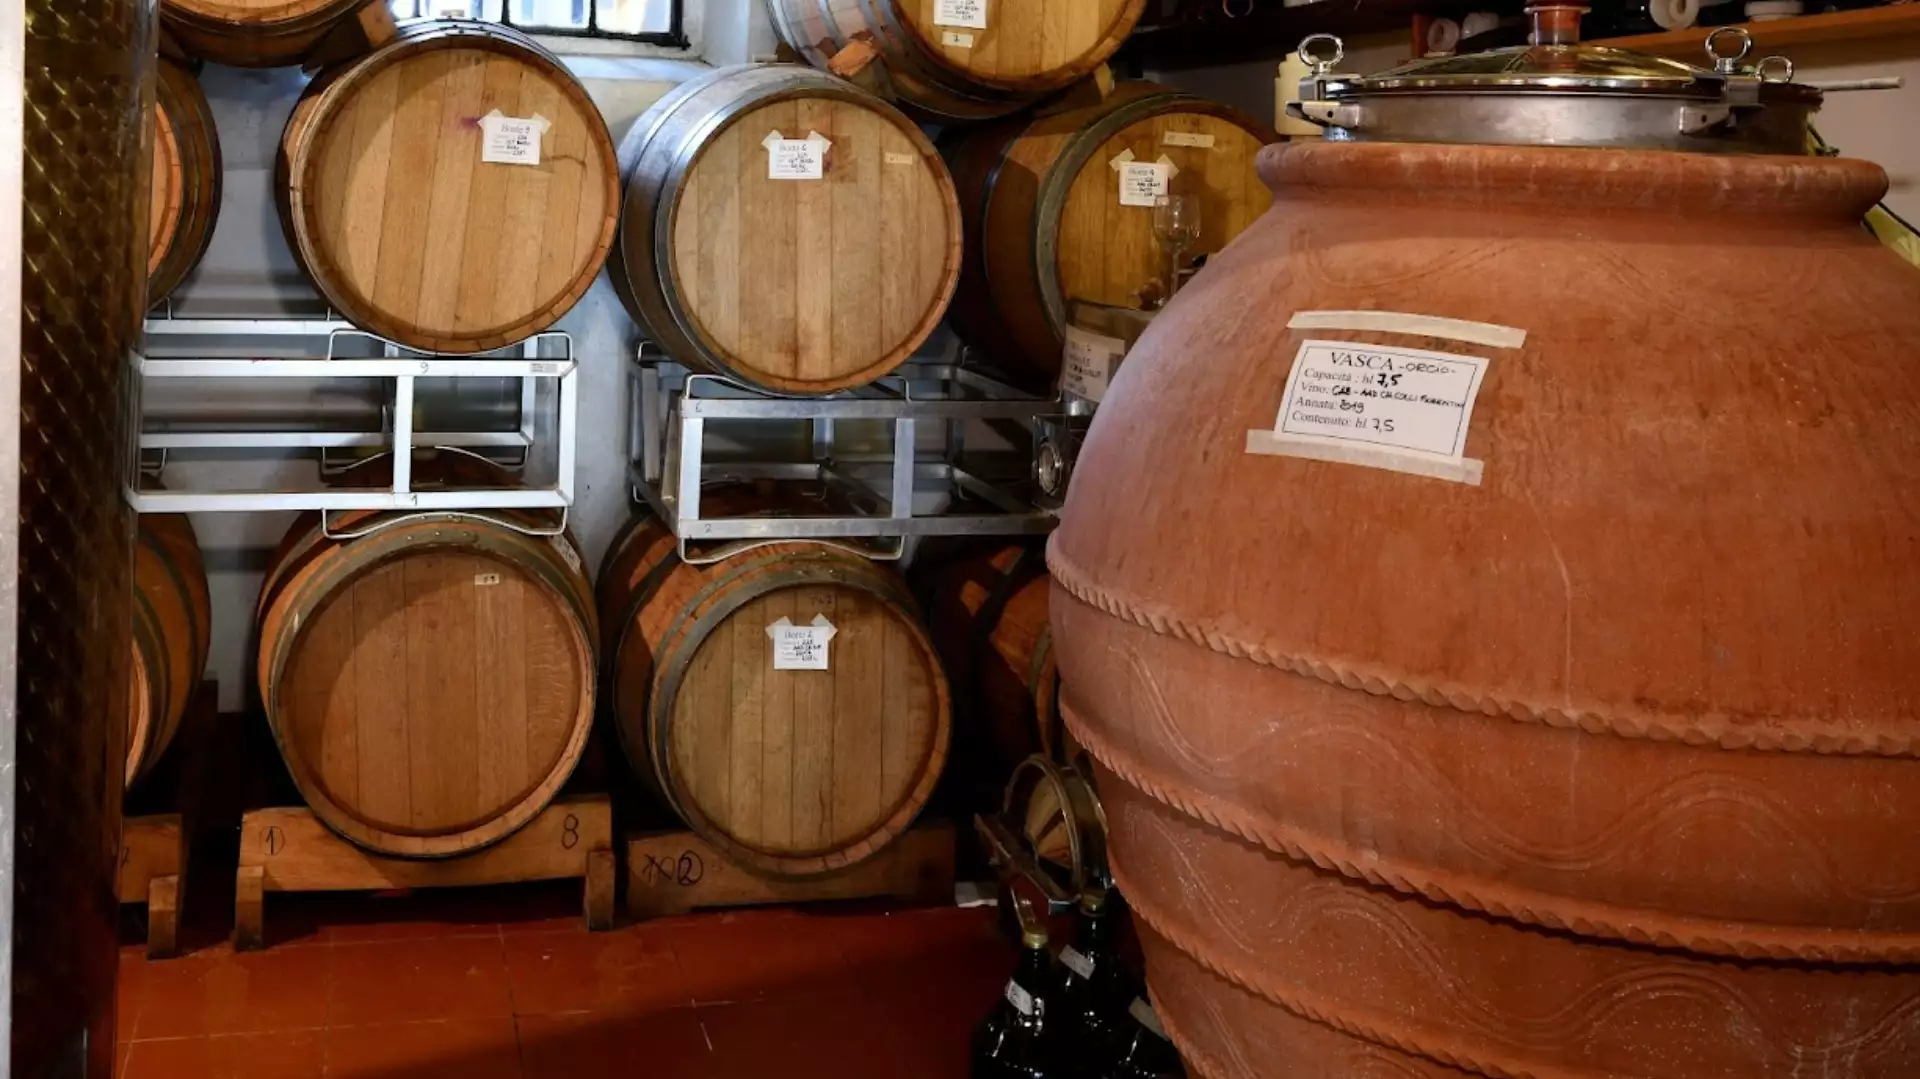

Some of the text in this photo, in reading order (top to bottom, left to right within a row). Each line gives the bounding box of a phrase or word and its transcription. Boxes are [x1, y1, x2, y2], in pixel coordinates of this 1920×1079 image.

[1331, 351, 1393, 371] VASCA
[1301, 381, 1329, 394] Vino:
[1361, 373, 1375, 385] hl
[1377, 373, 1404, 389] 7,5
[1295, 396, 1337, 410] Annata:
[1292, 410, 1395, 434] Contenuto: hl 7,5
[560, 813, 579, 850] 8
